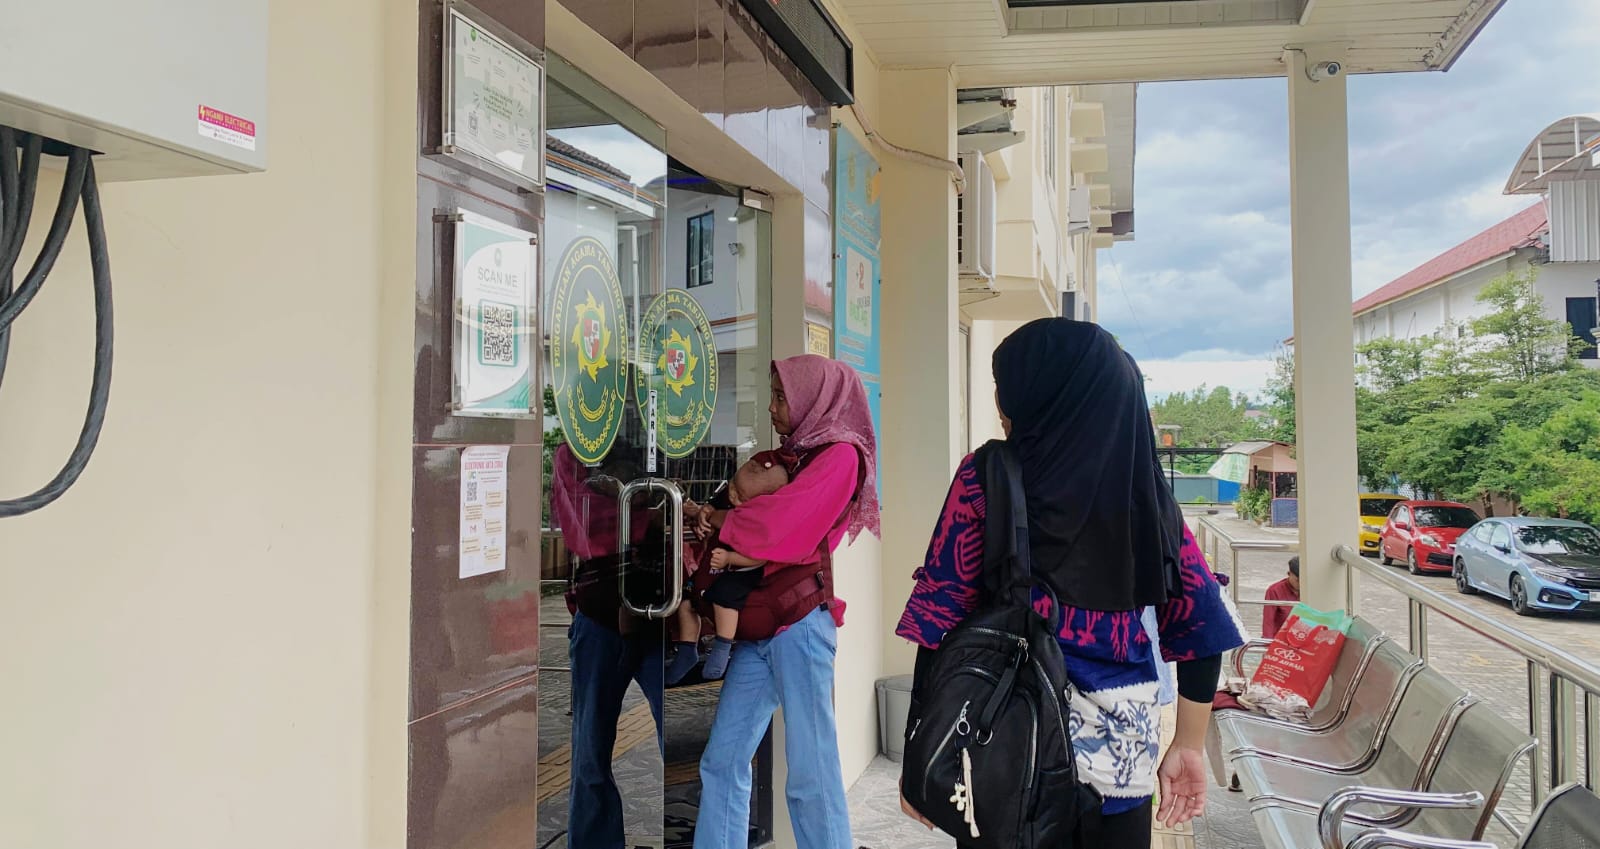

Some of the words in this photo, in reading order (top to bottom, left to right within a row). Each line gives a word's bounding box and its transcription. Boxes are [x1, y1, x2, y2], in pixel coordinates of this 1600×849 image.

[478, 267, 502, 284] SCAN
[504, 272, 518, 288] ME
[554, 266, 572, 368] PENGADILAN
[570, 245, 596, 267] AGAMA
[598, 250, 623, 309] TANJUNG
[618, 313, 627, 377] KARANG
[683, 298, 711, 340] TANJUNG
[706, 343, 716, 392] KARANG
